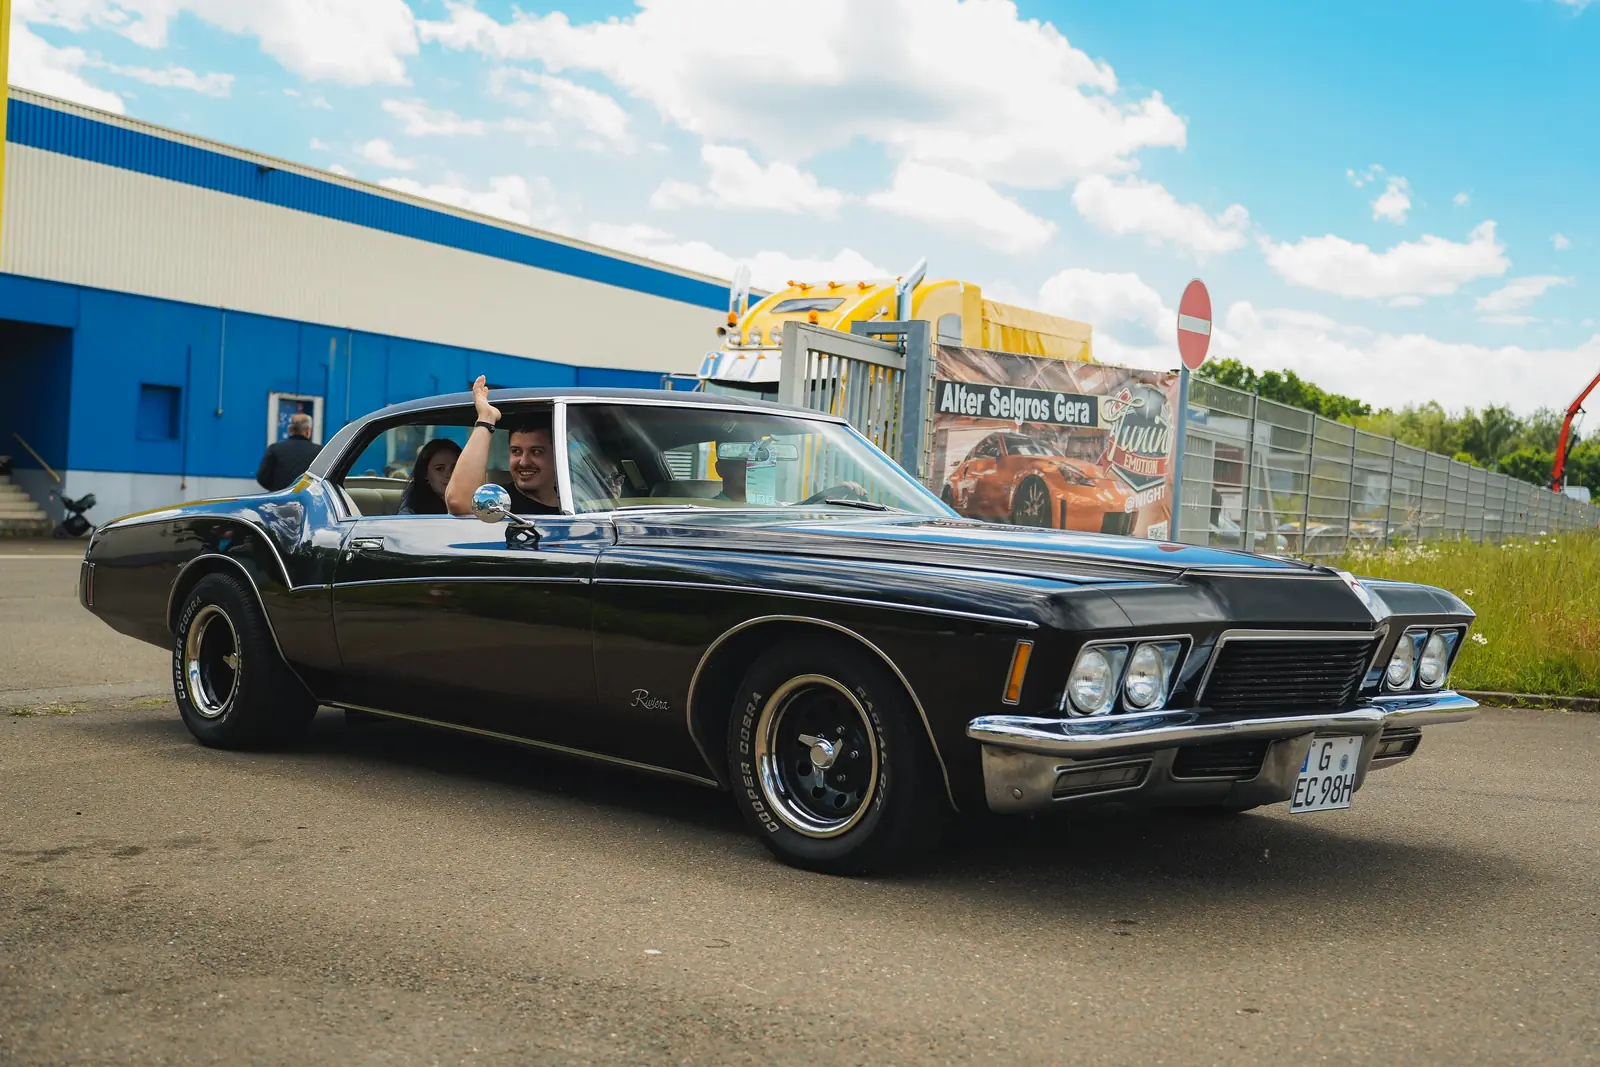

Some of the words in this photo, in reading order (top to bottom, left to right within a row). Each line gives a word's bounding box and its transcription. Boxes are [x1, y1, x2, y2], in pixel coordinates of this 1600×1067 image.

[940, 382, 985, 416] Alter
[989, 387, 1050, 426] Selgros
[1053, 393, 1090, 424] Gera
[1123, 453, 1159, 475] EMOTION
[180, 595, 202, 634] COBRA
[175, 638, 186, 700] COOPER
[739, 691, 762, 755] COBRA
[855, 685, 888, 765] RADIAL
[1318, 741, 1333, 771] G
[740, 761, 780, 833] COOPER
[1292, 776, 1319, 808] EC
[1319, 773, 1355, 805] 98H
